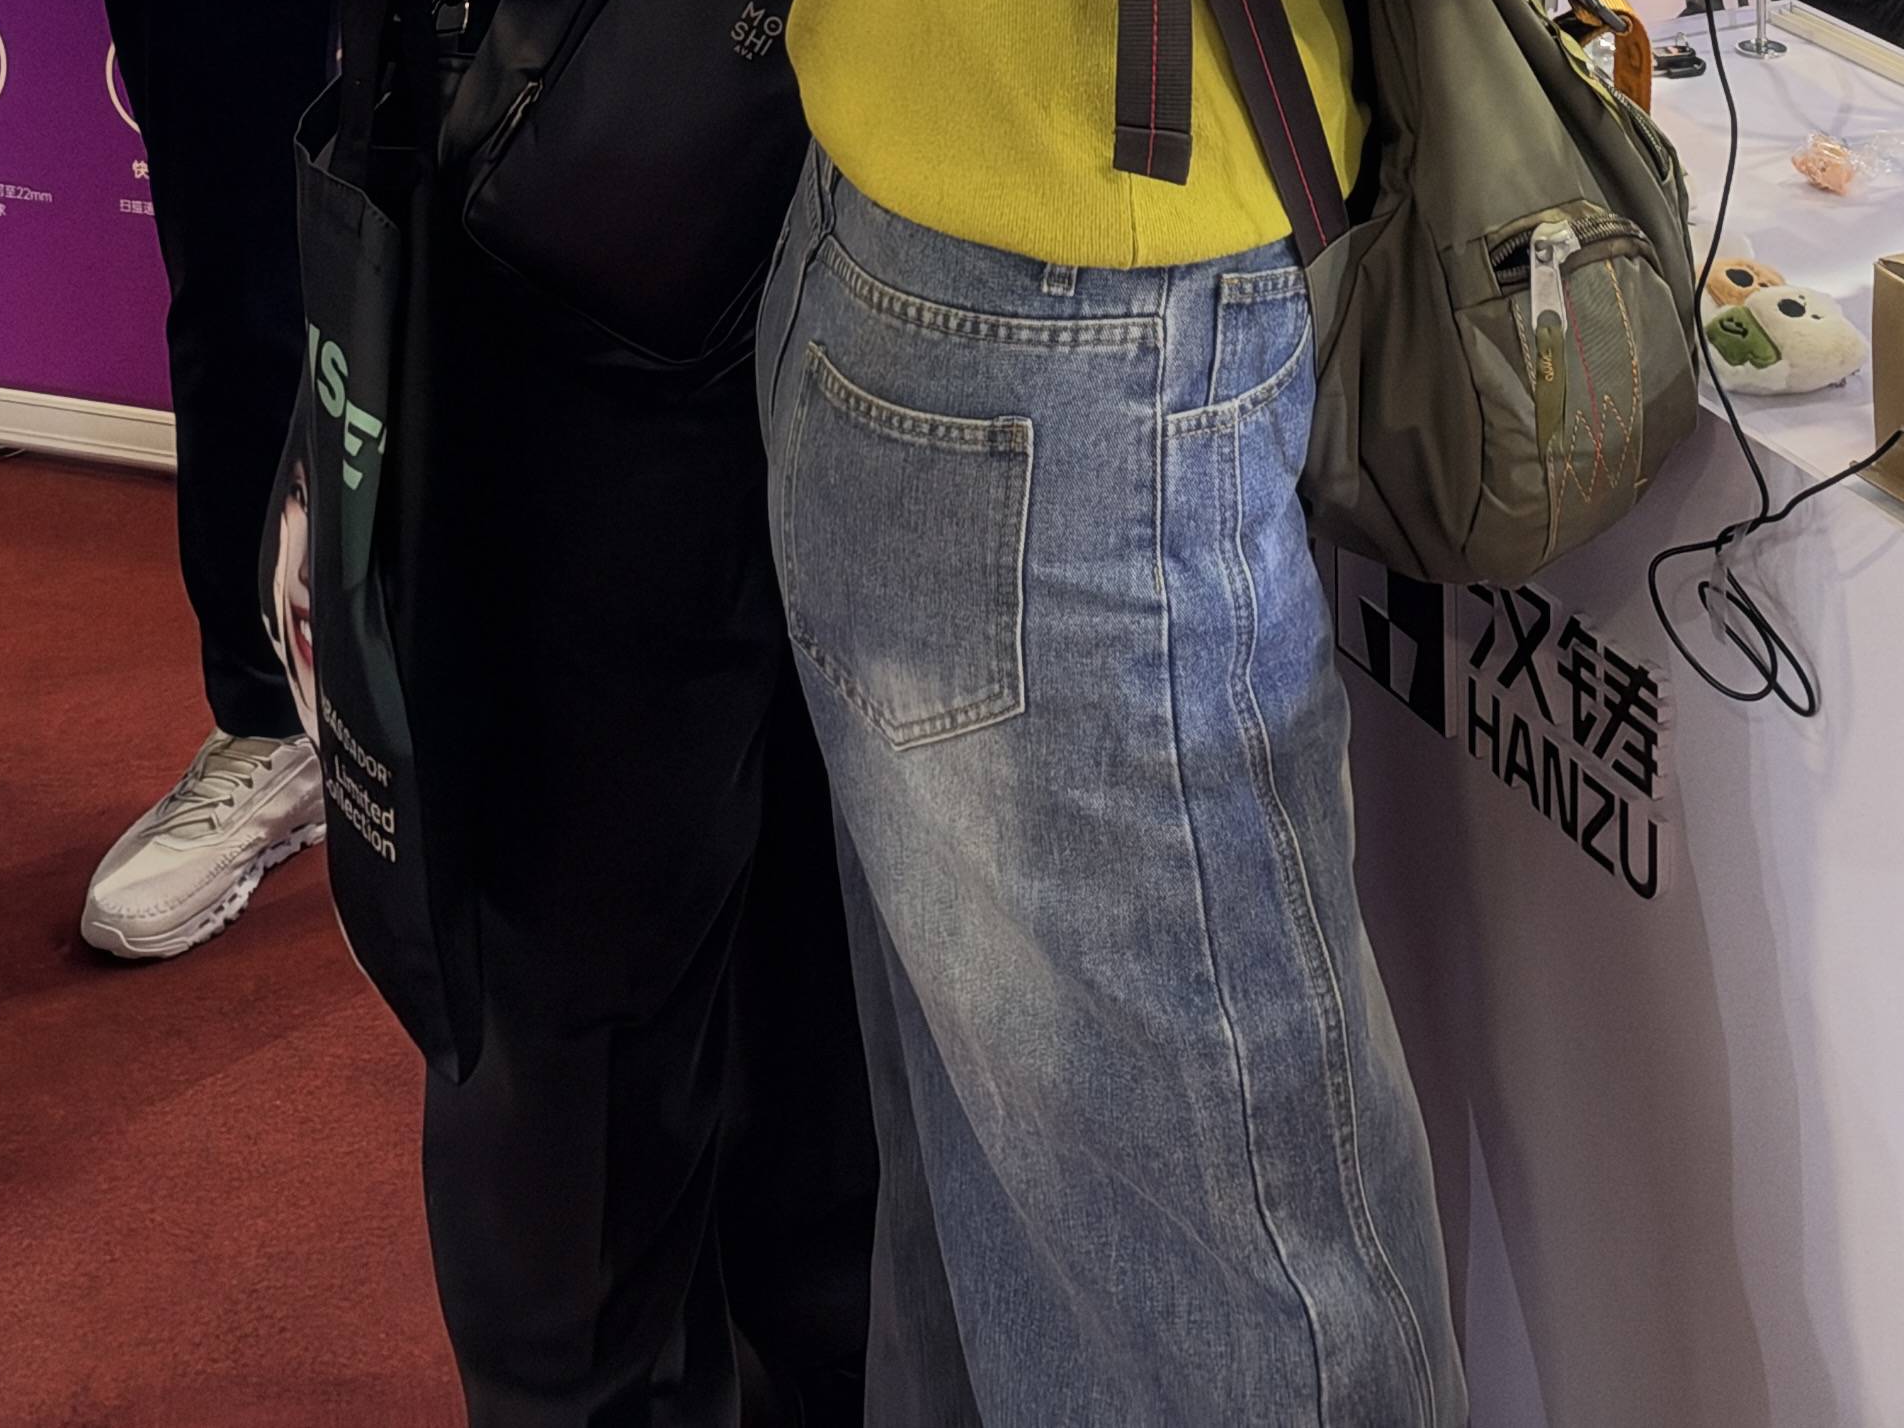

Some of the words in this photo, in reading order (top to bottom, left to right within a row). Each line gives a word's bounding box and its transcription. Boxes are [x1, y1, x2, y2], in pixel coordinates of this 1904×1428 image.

[334, 753, 395, 835] Limited
[1466, 580, 1665, 802] 汉铸
[1466, 675, 1665, 902] HANZU
